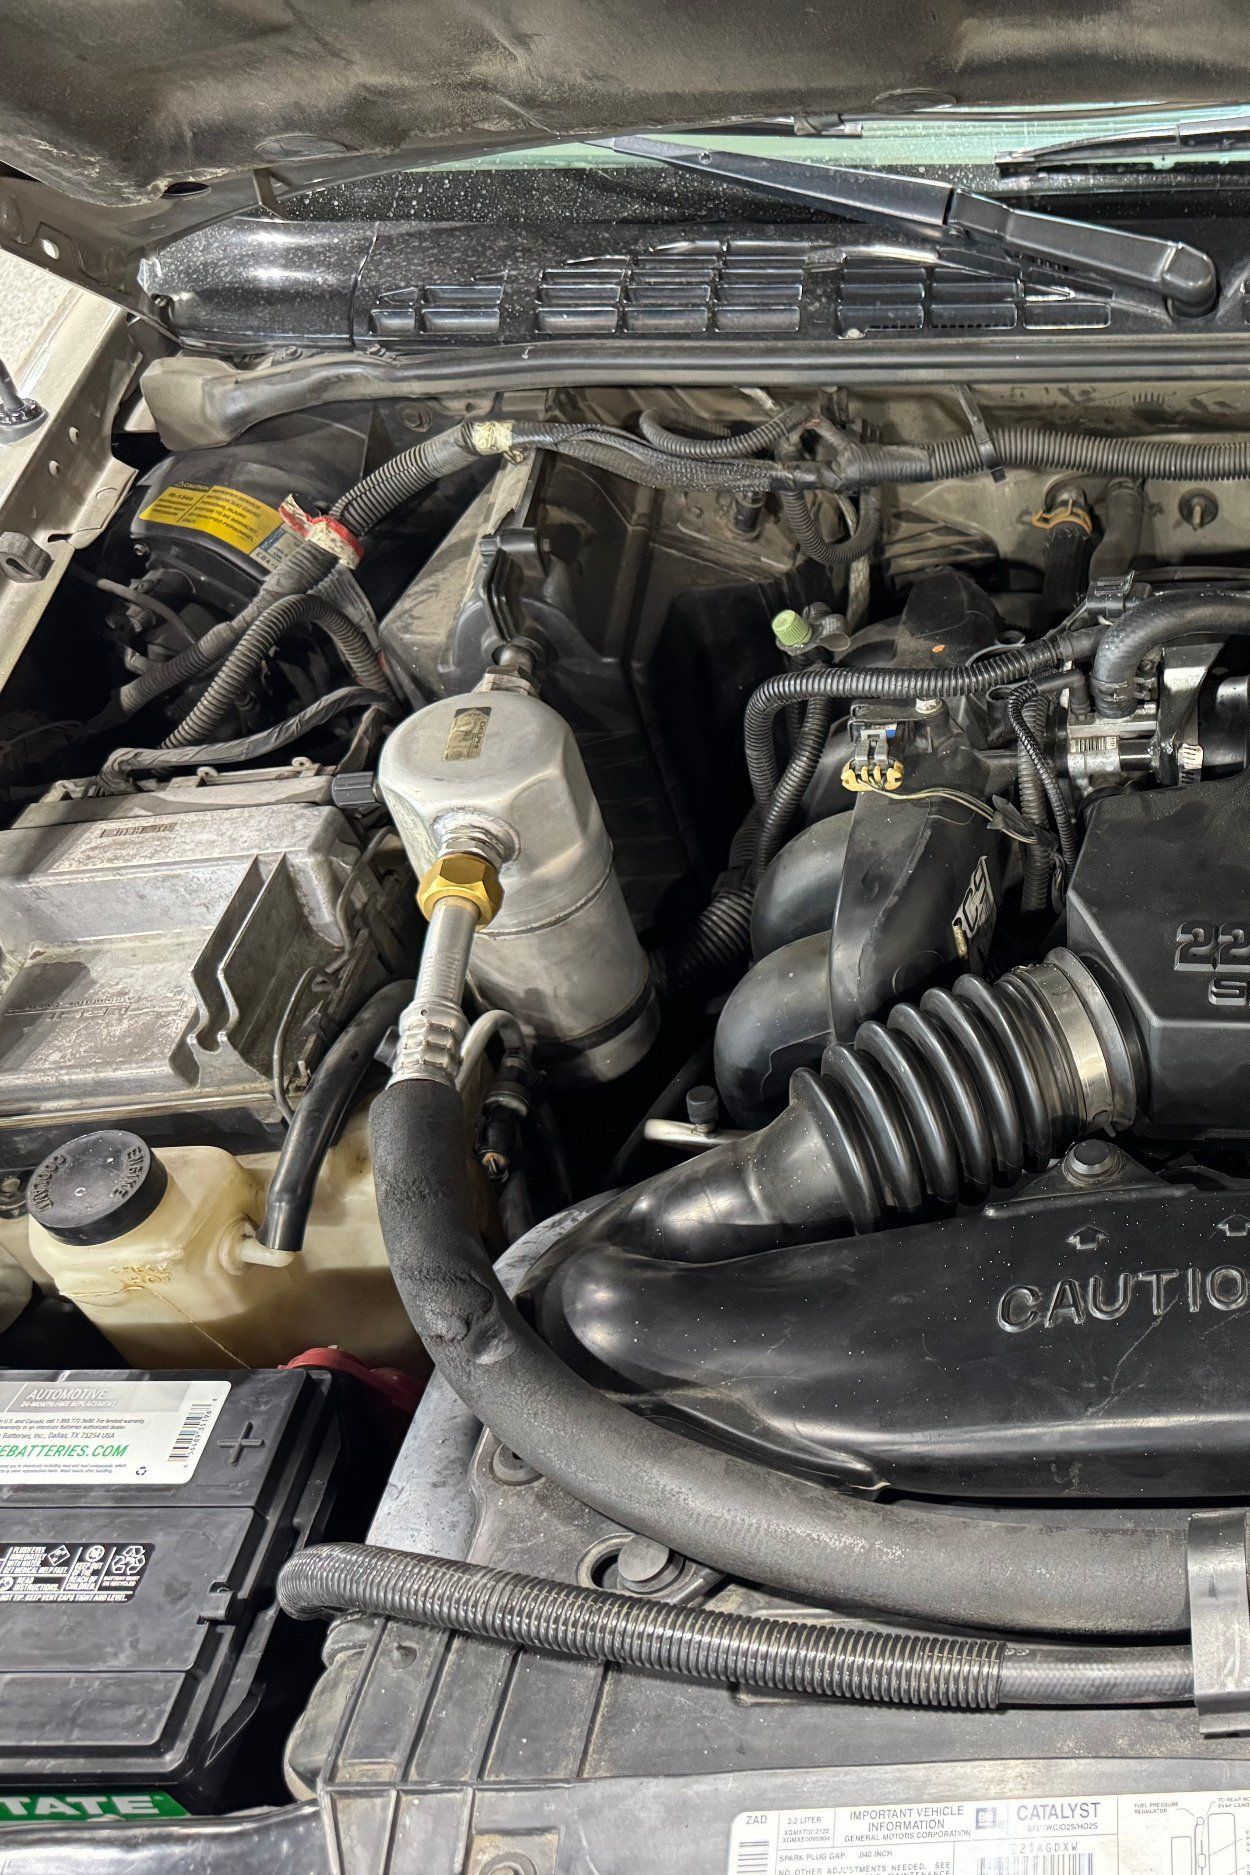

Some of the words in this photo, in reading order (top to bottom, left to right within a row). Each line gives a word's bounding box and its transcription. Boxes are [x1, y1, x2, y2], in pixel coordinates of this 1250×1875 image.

[113, 1146, 144, 1199] ENGINE
[33, 1154, 67, 1213] COOLANT
[26, 1389, 111, 1400] AUTOMOTIVE
[850, 1808, 913, 1821] IMPORTANT
[917, 1806, 964, 1817] VEHICLE
[1017, 1802, 1101, 1821] CATALYST
[746, 1815, 768, 1824] ZAD
[800, 1816, 822, 1824] LITER
[868, 1819, 945, 1832] INFORMATION
[844, 1833, 880, 1842] GENERAL
[882, 1832, 912, 1841] MOTORS
[913, 1829, 971, 1839] CORPORATION
[779, 1853, 803, 1861] SPARK
[805, 1852, 827, 1860] PLUG
[874, 1850, 892, 1858] INCH
[827, 1865, 887, 1875] ADJUSTMENTS
[891, 1862, 926, 1872] NEEDED.
[935, 1861, 951, 1869] SEE
